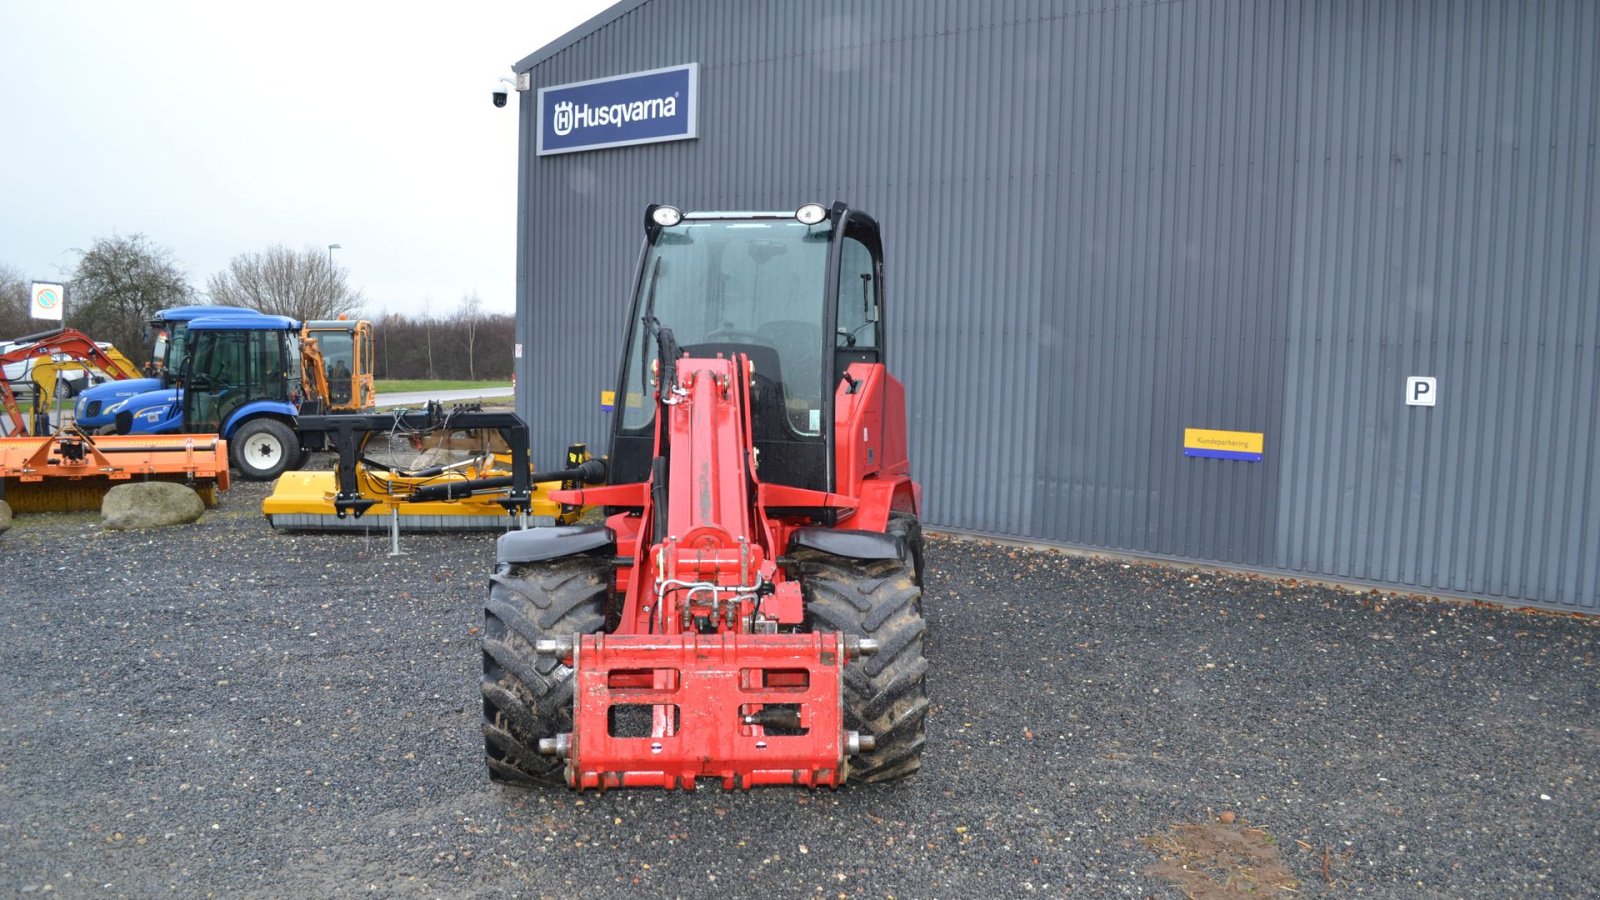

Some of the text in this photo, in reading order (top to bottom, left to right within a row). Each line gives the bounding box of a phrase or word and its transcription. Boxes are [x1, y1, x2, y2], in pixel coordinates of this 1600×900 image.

[574, 96, 676, 128] Husqvarna
[1414, 381, 1430, 401] P
[1197, 437, 1249, 449] Kundeparkering
